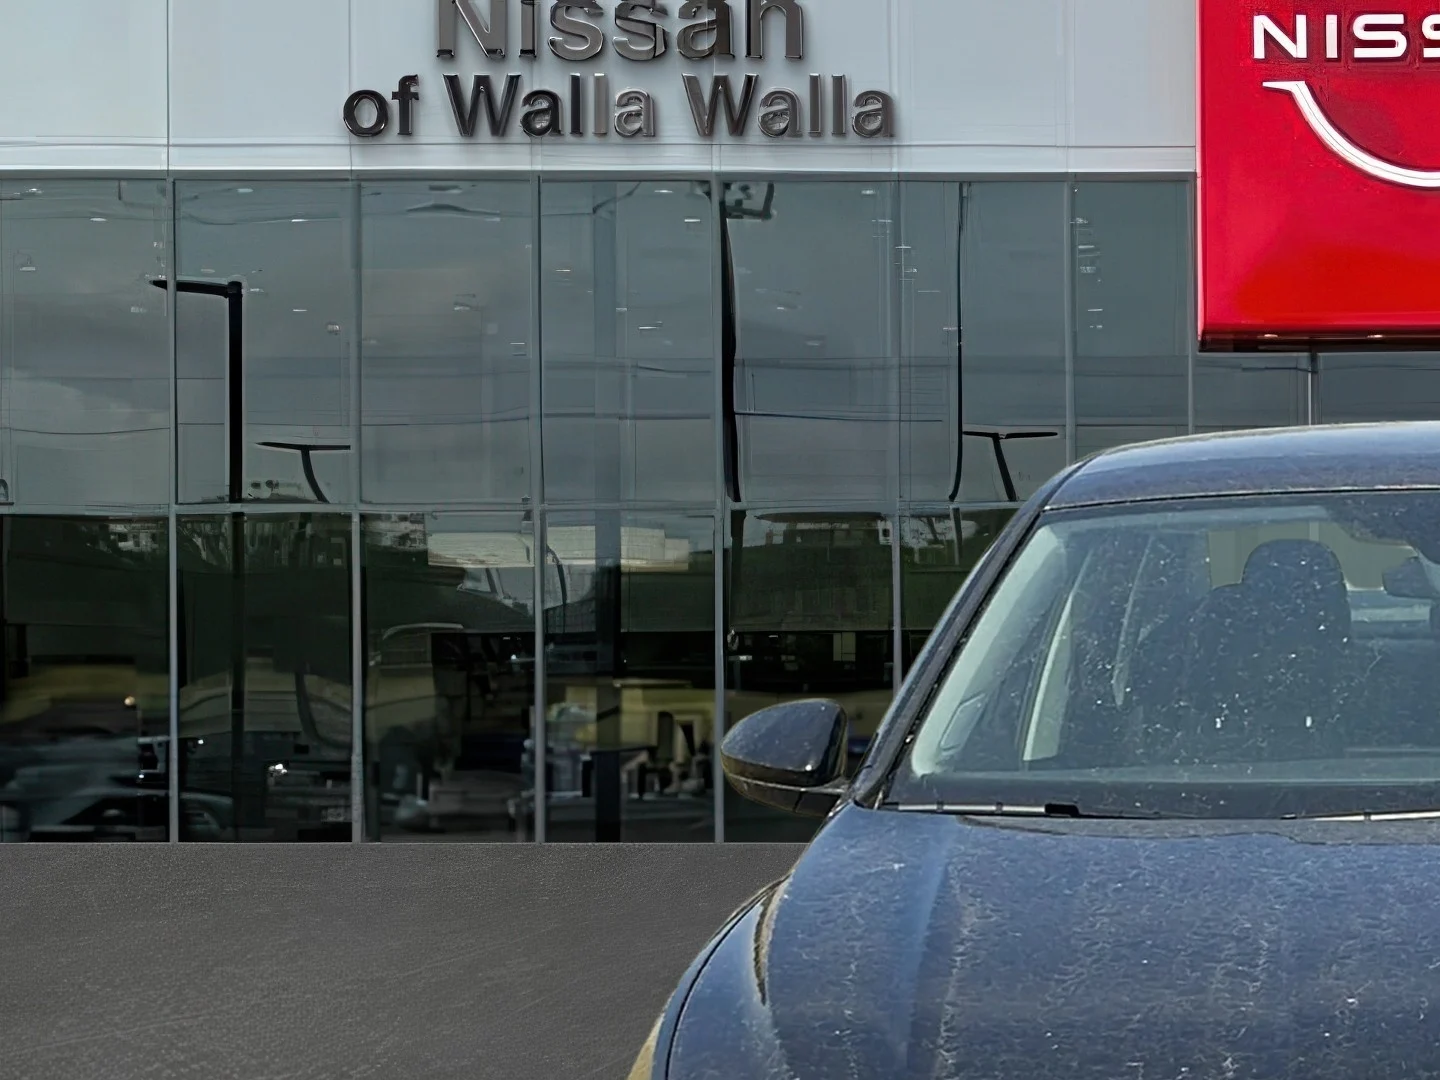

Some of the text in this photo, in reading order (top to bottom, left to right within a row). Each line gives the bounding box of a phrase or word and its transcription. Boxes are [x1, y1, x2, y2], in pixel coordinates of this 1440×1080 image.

[342, 72, 894, 138] of Walla Walla
